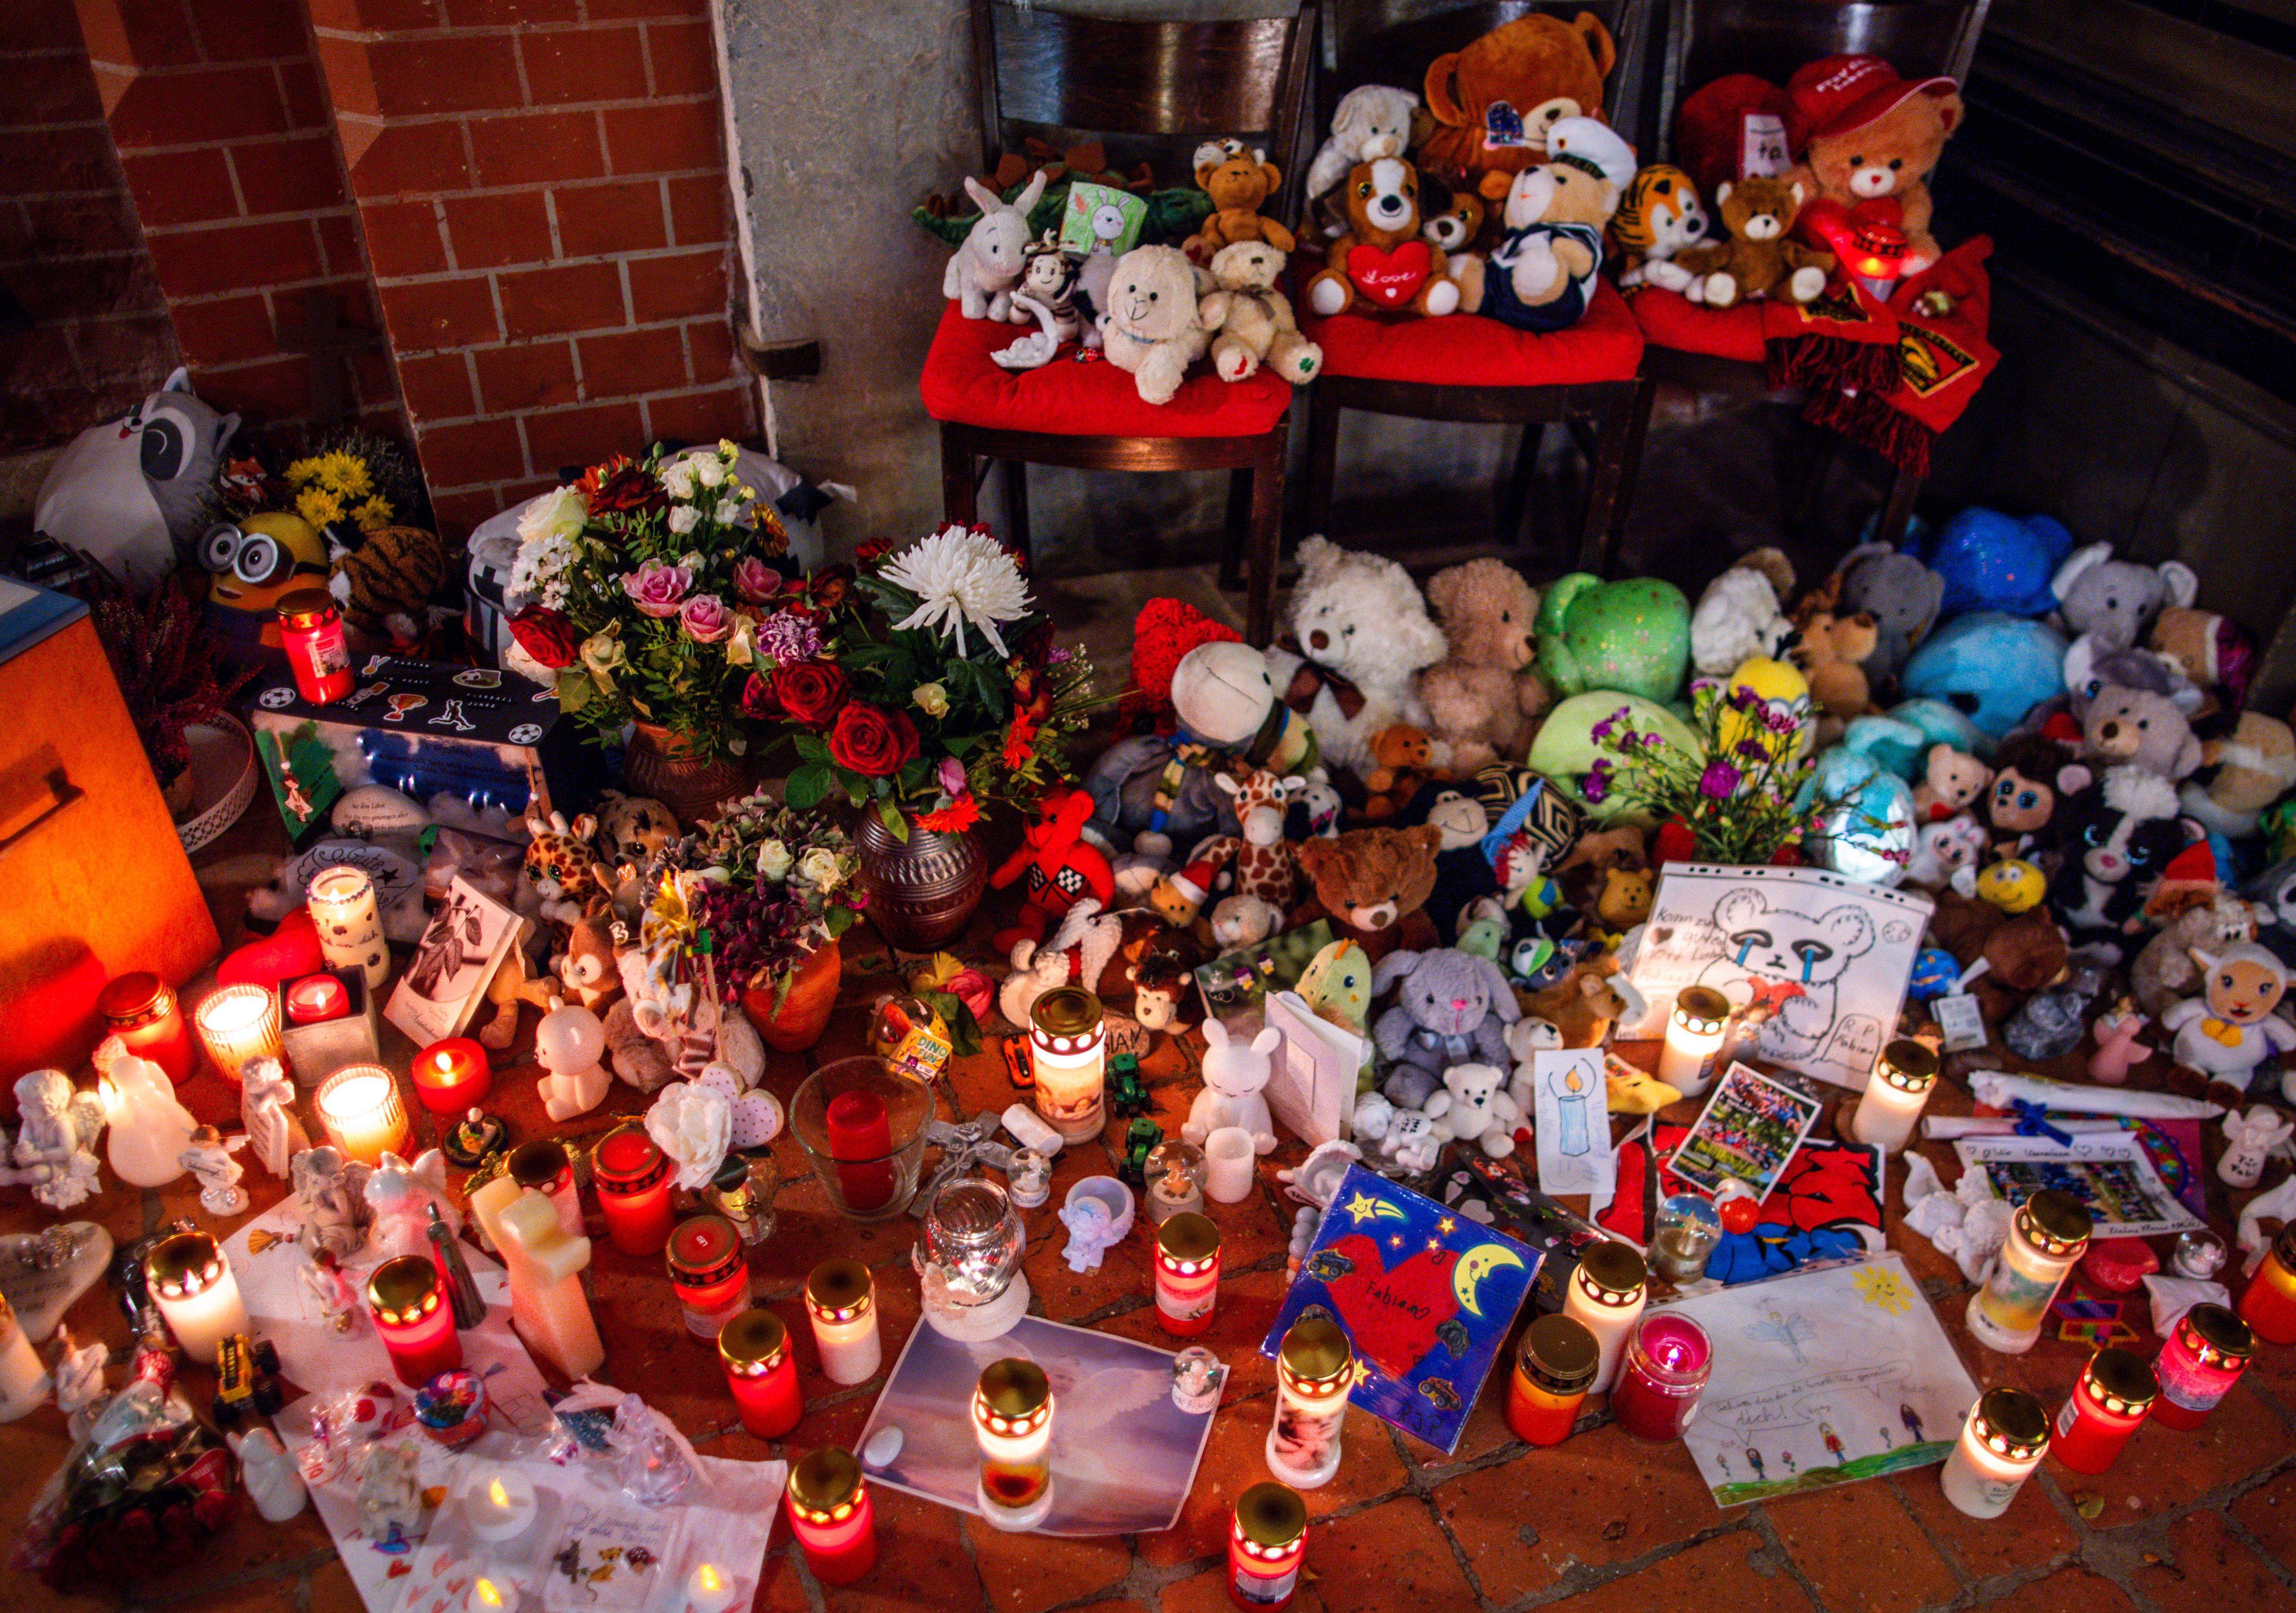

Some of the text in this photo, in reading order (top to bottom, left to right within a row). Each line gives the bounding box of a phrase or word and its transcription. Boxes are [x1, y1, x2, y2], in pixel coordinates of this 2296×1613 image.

[1362, 269, 1416, 284] Love
[917, 1035, 948, 1057] DINO
[918, 1048, 938, 1064] FUN
[696, 1235, 709, 1247] LED
[1366, 1281, 1419, 1315] Fabian
